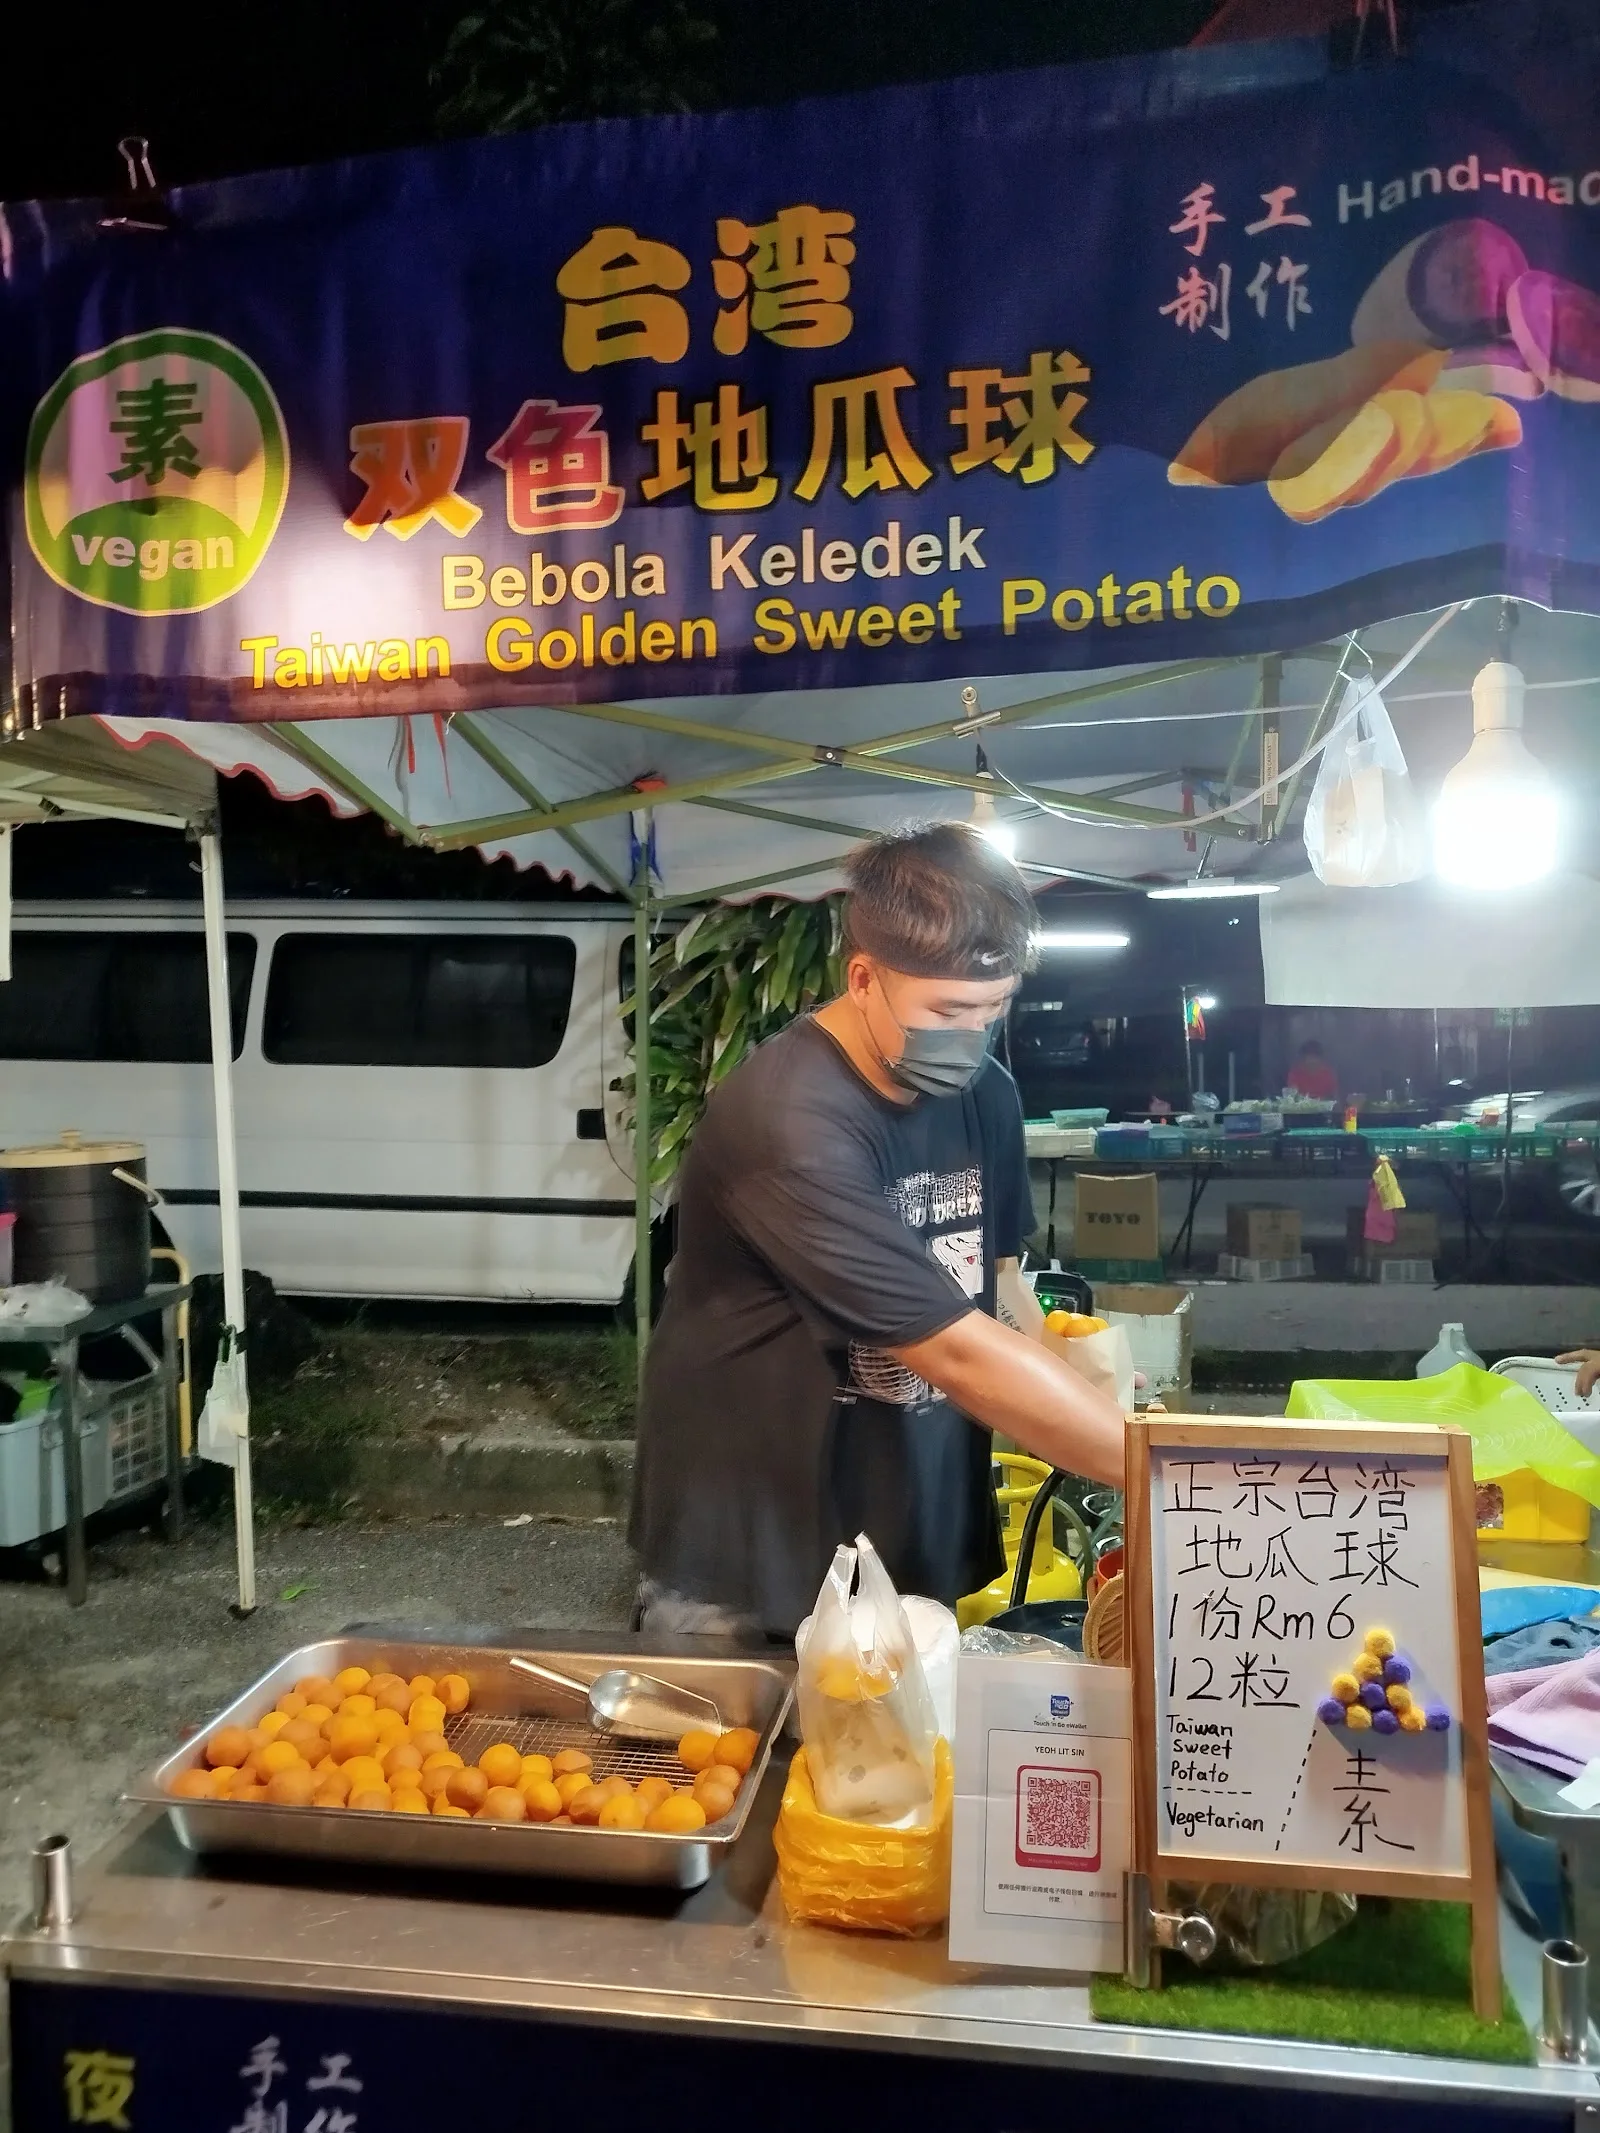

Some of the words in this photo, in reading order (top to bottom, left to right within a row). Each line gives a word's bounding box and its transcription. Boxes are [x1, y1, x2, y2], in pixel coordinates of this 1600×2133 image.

[1169, 181, 1312, 256] 手工
[556, 206, 857, 373] 台湾
[1158, 254, 1314, 341] 制作
[108, 377, 206, 484] 素
[344, 350, 1096, 542] 双色地瓜球
[72, 532, 235, 581] vegan
[441, 545, 666, 611] Bebola
[710, 516, 987, 590] Keledek
[240, 633, 451, 690] Taiwan
[485, 613, 718, 673] Golden
[752, 589, 963, 652] Sweet
[1002, 565, 1242, 636] Potato
[1162, 1456, 1416, 1530] 正宗台湾
[1177, 1524, 1419, 1588] 地瓜球
[1035, 1746, 1057, 1754] YEOH
[1058, 1747, 1070, 1755] LIT
[1071, 1748, 1085, 1756] SIN
[1166, 1714, 1233, 1737] Taiwan
[1173, 1739, 1232, 1759] Sweet
[1171, 1760, 1229, 1782] Potato
[1166, 1801, 1263, 1837] Vegetarian
[63, 2050, 135, 2130] 夜
[240, 2036, 363, 2095] 手工
